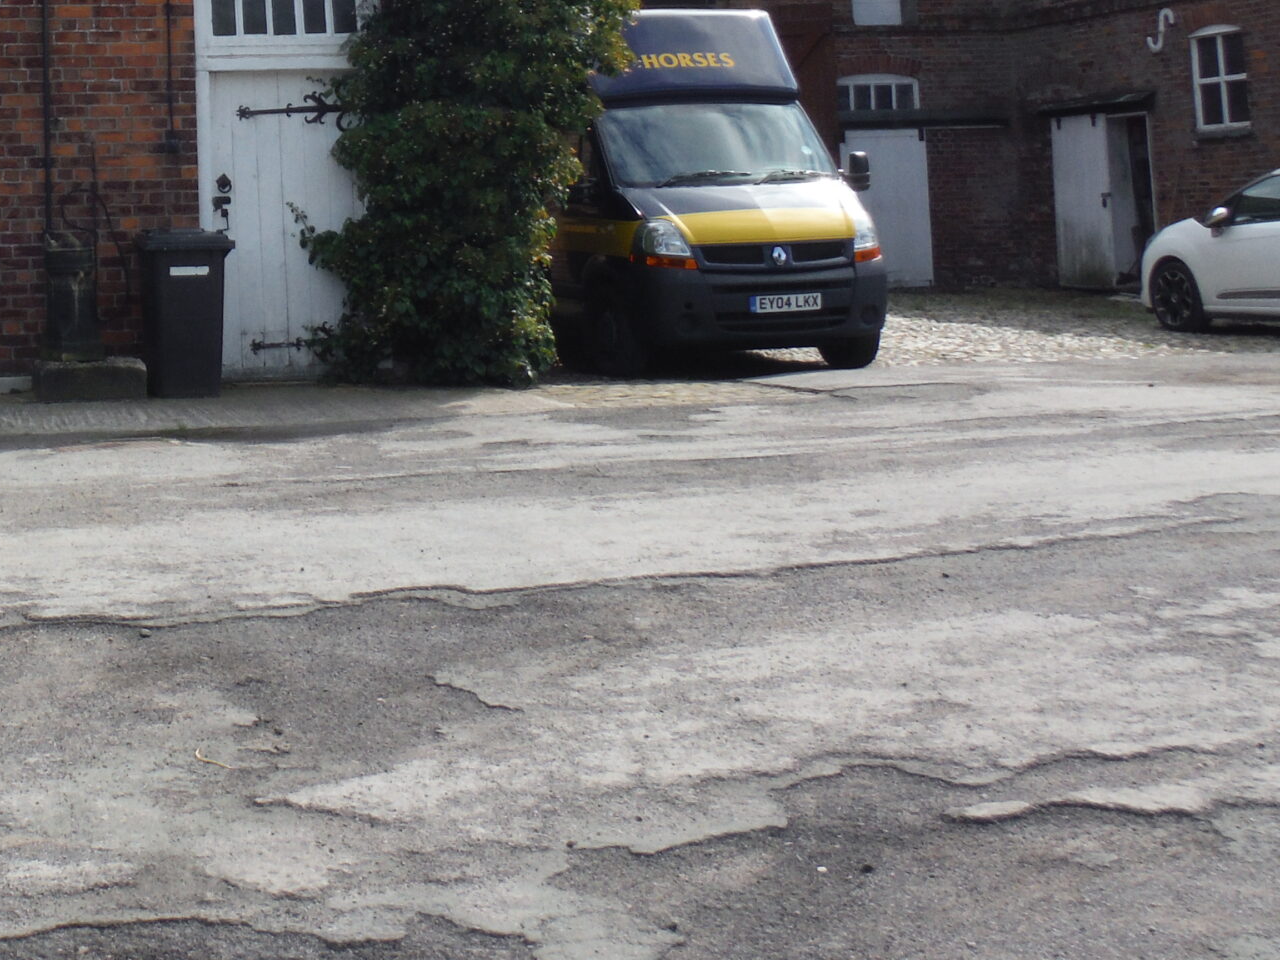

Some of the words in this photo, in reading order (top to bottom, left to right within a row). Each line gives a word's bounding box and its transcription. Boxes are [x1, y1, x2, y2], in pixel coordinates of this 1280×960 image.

[640, 52, 736, 69] HORSES
[759, 296, 792, 310] EY04
[795, 295, 819, 309] LKX
